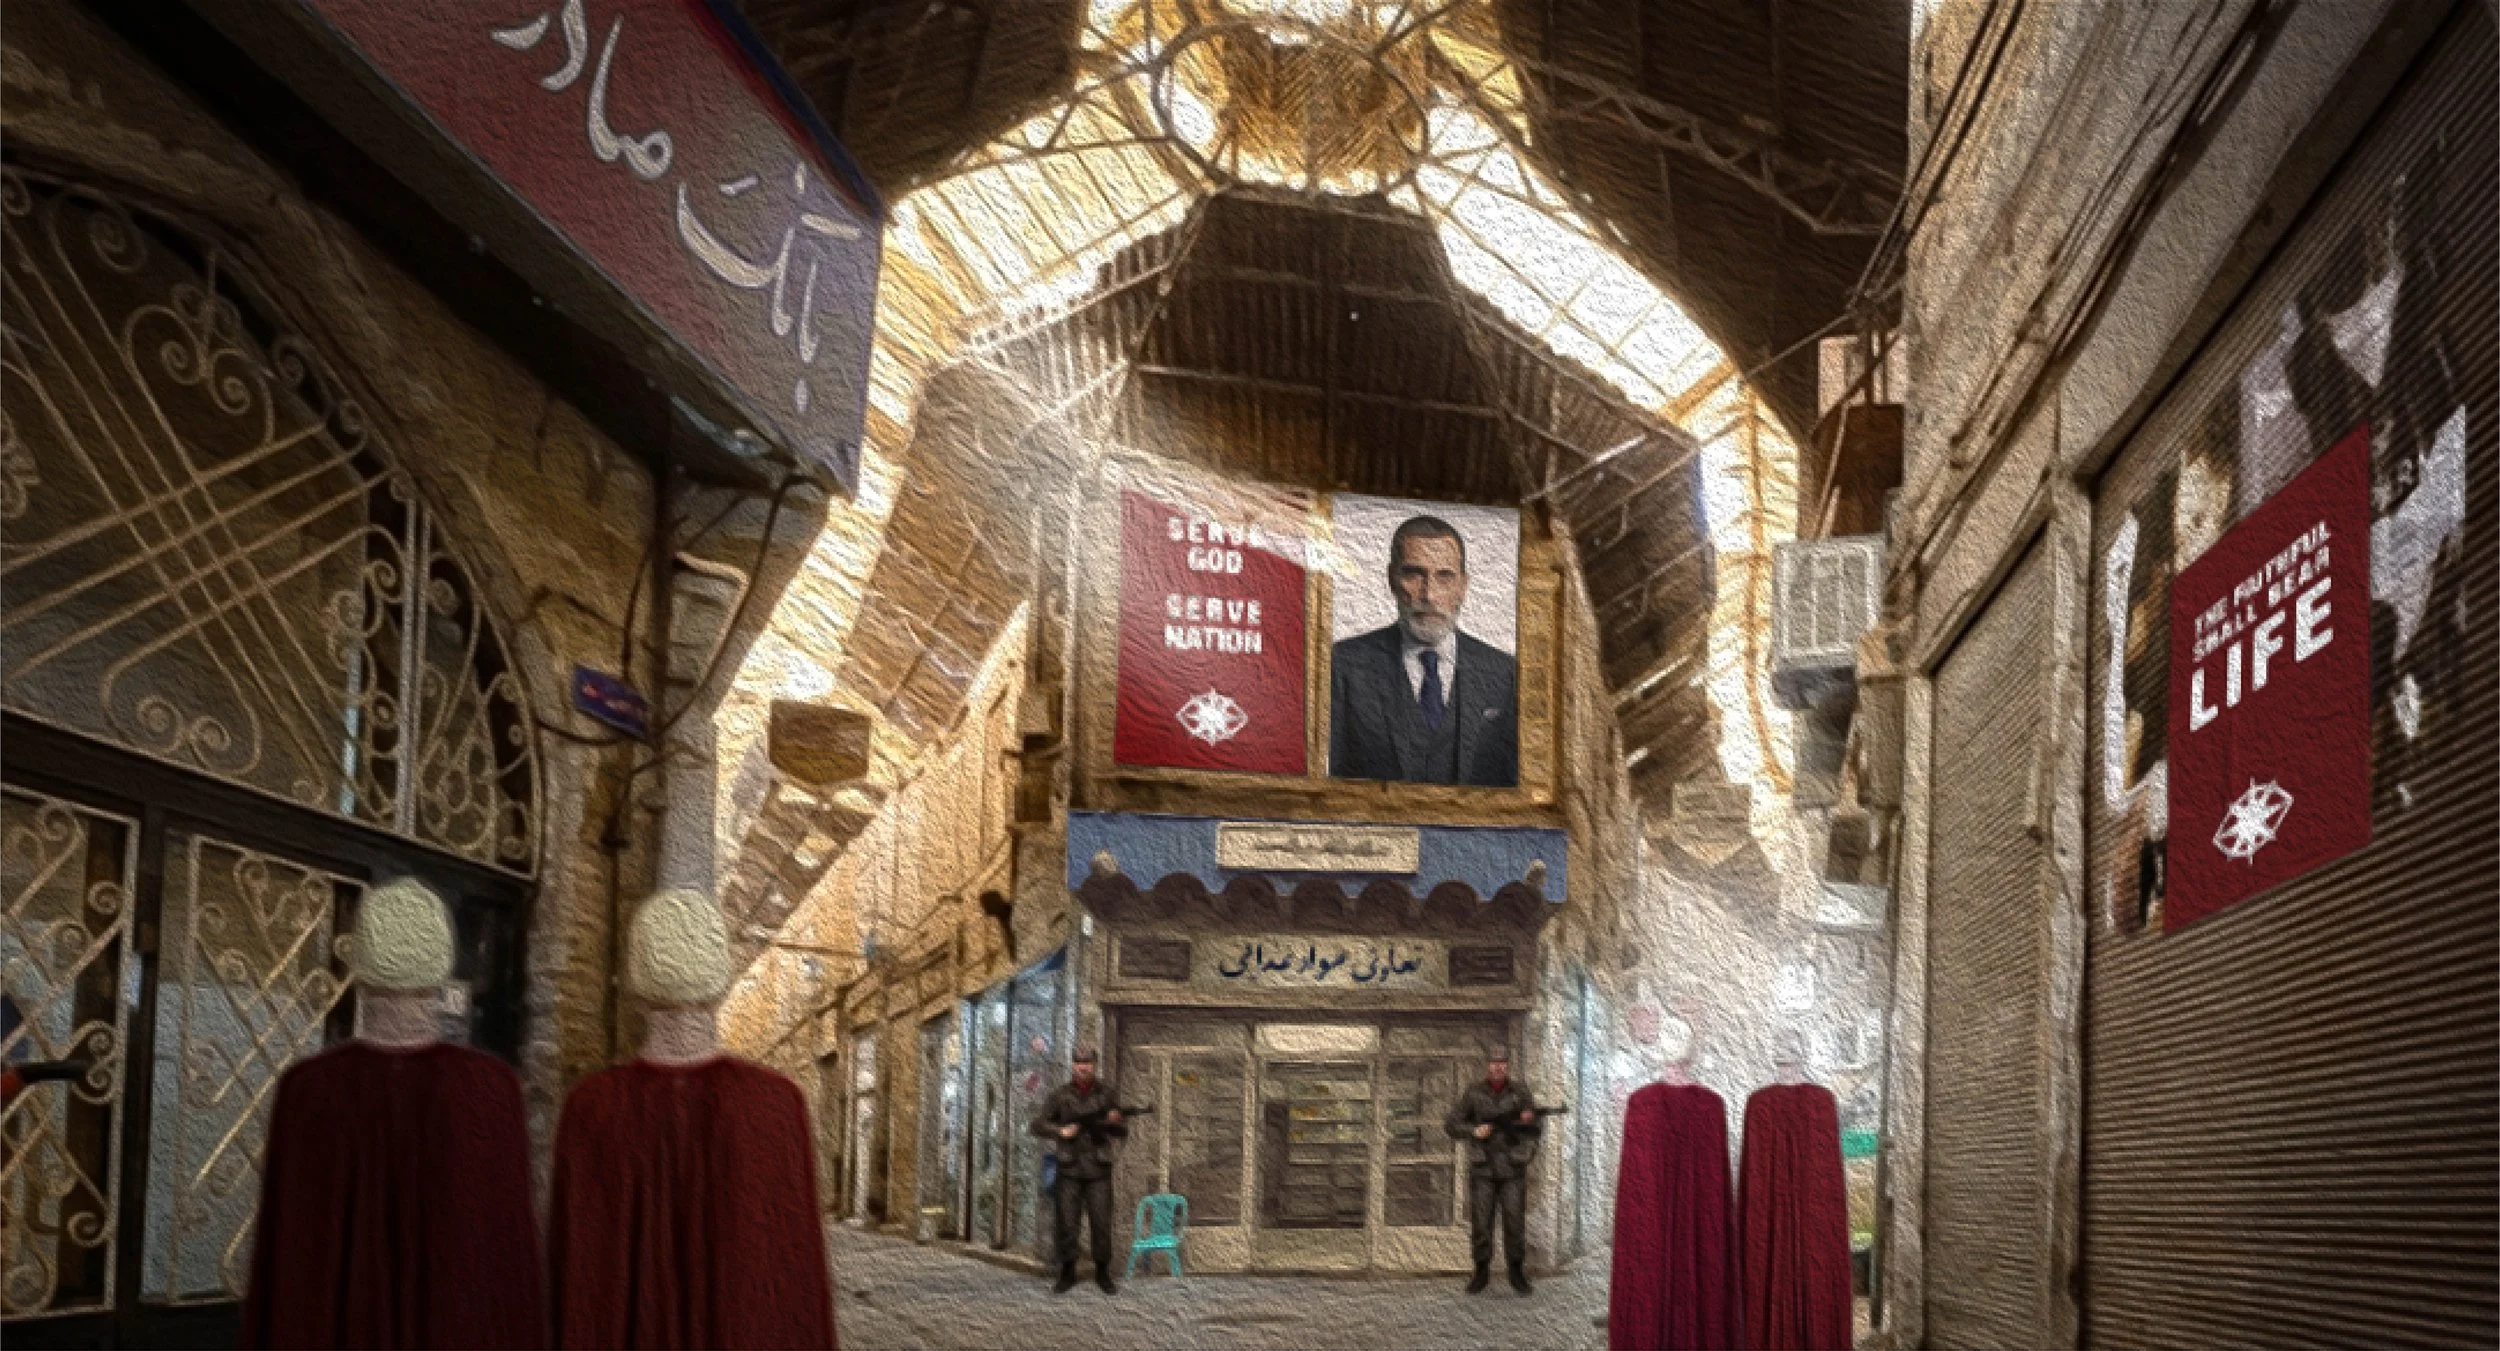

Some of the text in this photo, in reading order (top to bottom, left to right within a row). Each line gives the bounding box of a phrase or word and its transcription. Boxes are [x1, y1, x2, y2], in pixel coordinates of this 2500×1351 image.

[677, 160, 862, 414] بانک
[1167, 516, 1263, 548] SERVE
[1187, 546, 1243, 574] GOD
[1166, 593, 1262, 625] SERVE
[2192, 544, 2330, 663] SHALL BEAR
[2194, 596, 2228, 641] THE
[1164, 624, 1262, 654] NATION
[2189, 576, 2334, 733] LIFE
